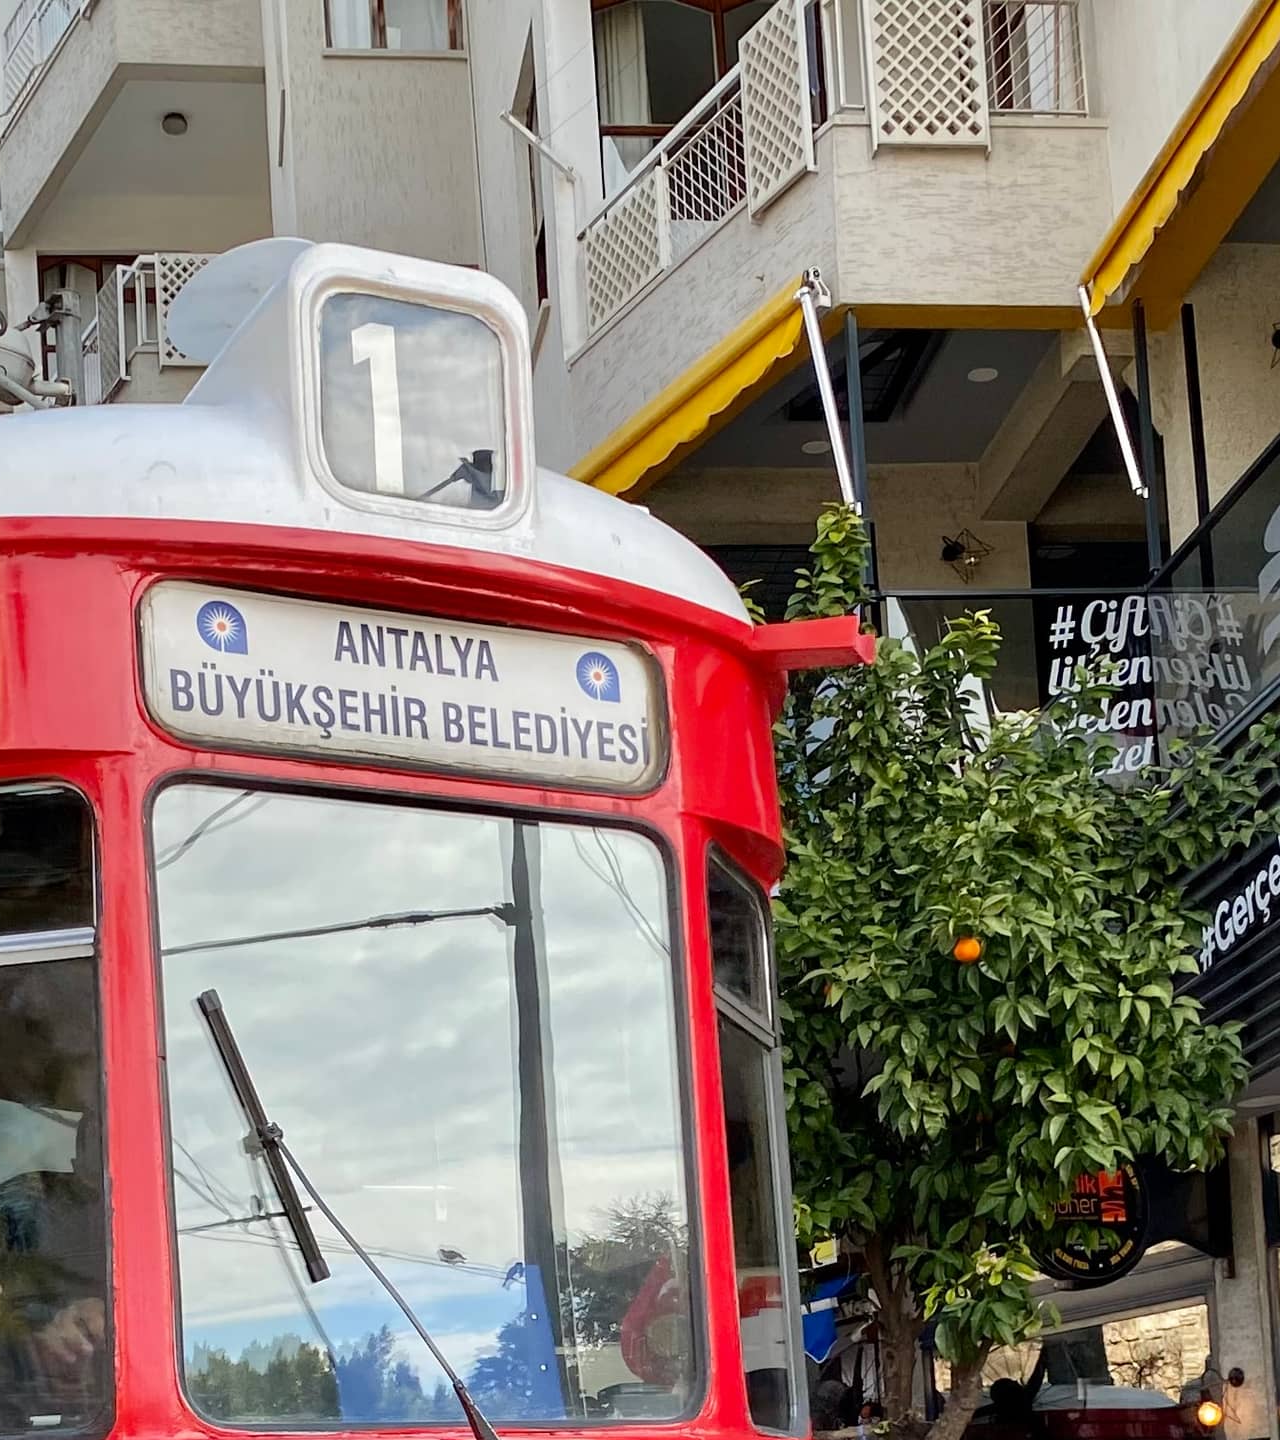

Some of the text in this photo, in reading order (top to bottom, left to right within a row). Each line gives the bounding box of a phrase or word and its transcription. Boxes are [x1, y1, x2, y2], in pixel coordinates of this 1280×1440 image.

[351, 322, 405, 493] 1
[334, 620, 499, 682] ANTALYA
[168, 662, 650, 765] BÜYÜKŞEHİR BELEDİYESİ
